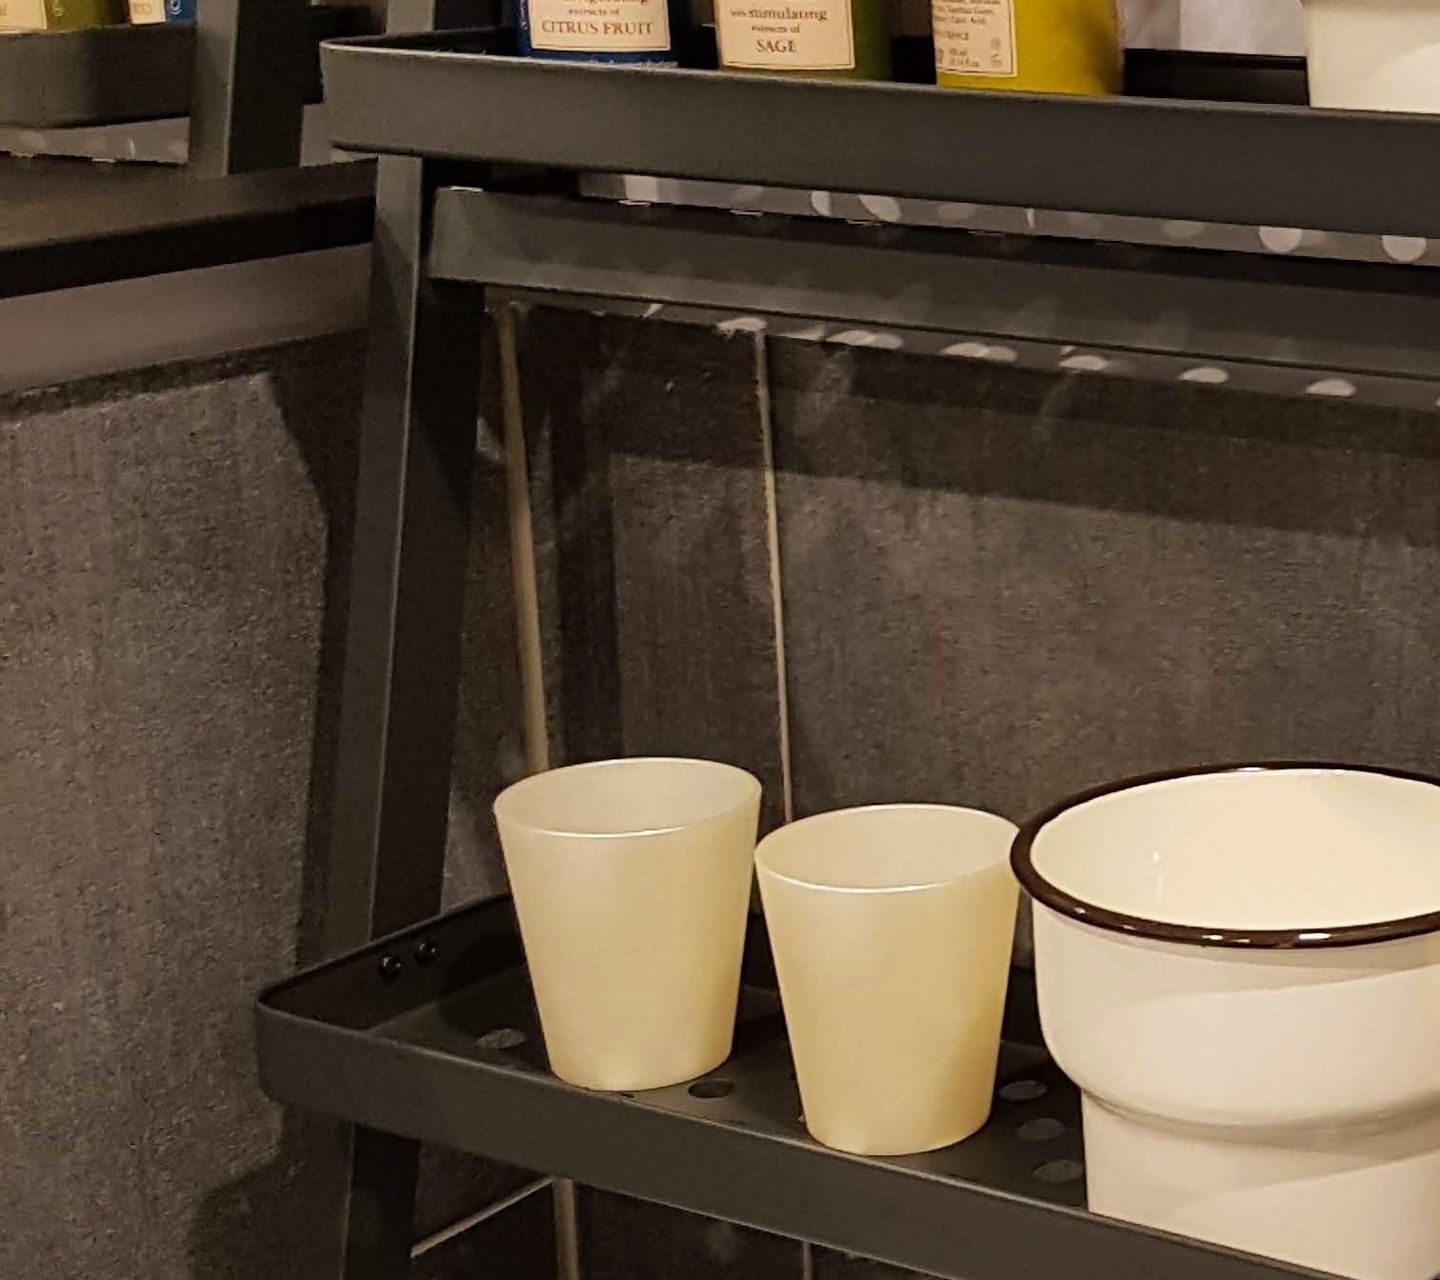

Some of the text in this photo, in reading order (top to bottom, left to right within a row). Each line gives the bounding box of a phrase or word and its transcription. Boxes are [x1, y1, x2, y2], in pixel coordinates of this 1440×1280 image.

[749, 7, 829, 22] stimulating
[542, 20, 654, 36] CITRUS FRUIT
[756, 39, 798, 53] SAGE
